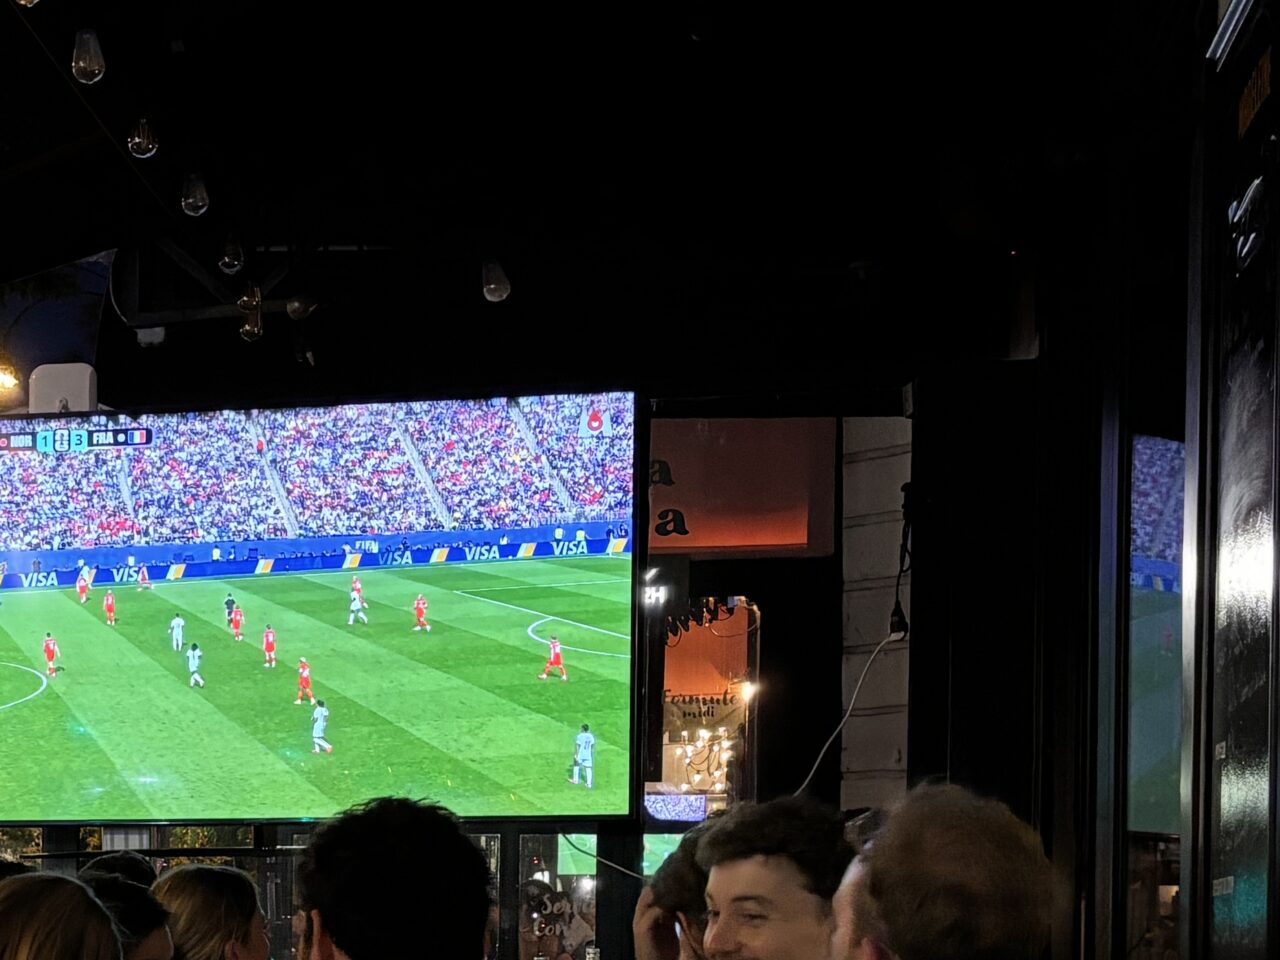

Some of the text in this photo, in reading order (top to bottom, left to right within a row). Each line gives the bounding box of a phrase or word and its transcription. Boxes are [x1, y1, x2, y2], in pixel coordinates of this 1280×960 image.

[10, 434, 33, 448] NOR
[41, 435, 48, 448] 1
[75, 433, 83, 447] 3
[93, 431, 114, 445] FRA
[464, 544, 500, 561] VISA
[551, 541, 588, 556] VISA
[378, 549, 413, 566] VISA
[19, 571, 59, 588] VISA
